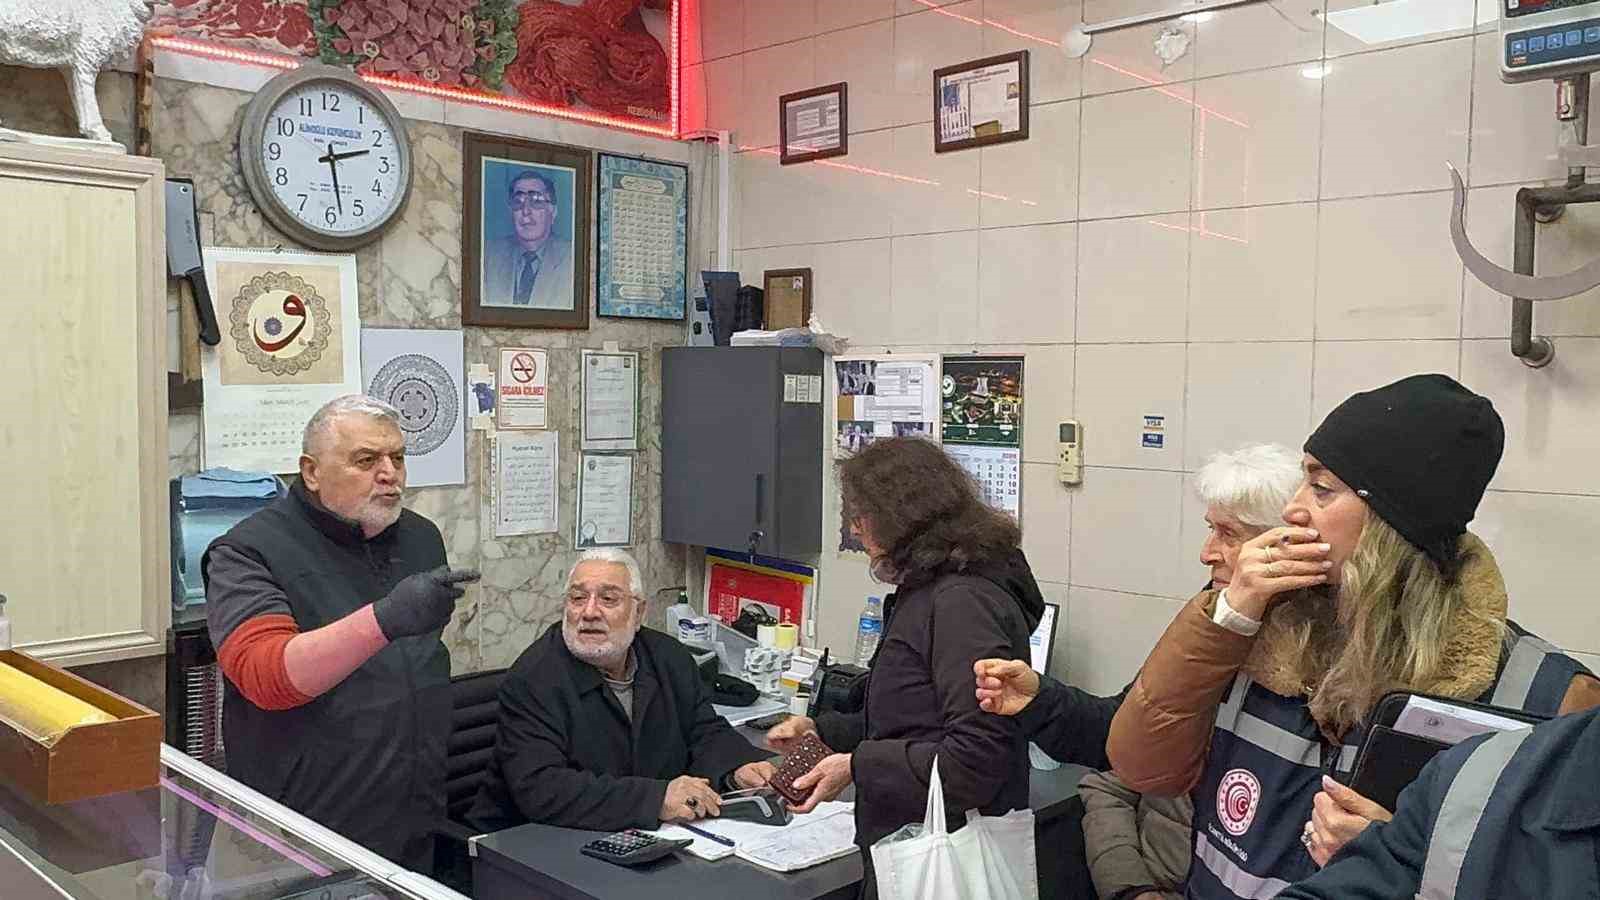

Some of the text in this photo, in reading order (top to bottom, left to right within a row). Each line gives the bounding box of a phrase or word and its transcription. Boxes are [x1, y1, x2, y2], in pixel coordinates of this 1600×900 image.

[300, 98, 313, 117] 11
[322, 92, 340, 112] 12
[358, 106, 364, 124] 1
[277, 117, 295, 137] 10
[372, 130, 383, 148] 2
[268, 142, 281, 161] 9
[378, 156, 390, 174] 3
[276, 167, 288, 186] 8
[371, 178, 383, 197] 4
[297, 193, 308, 211] 7
[352, 199, 364, 217] 5
[325, 206, 337, 225] 6
